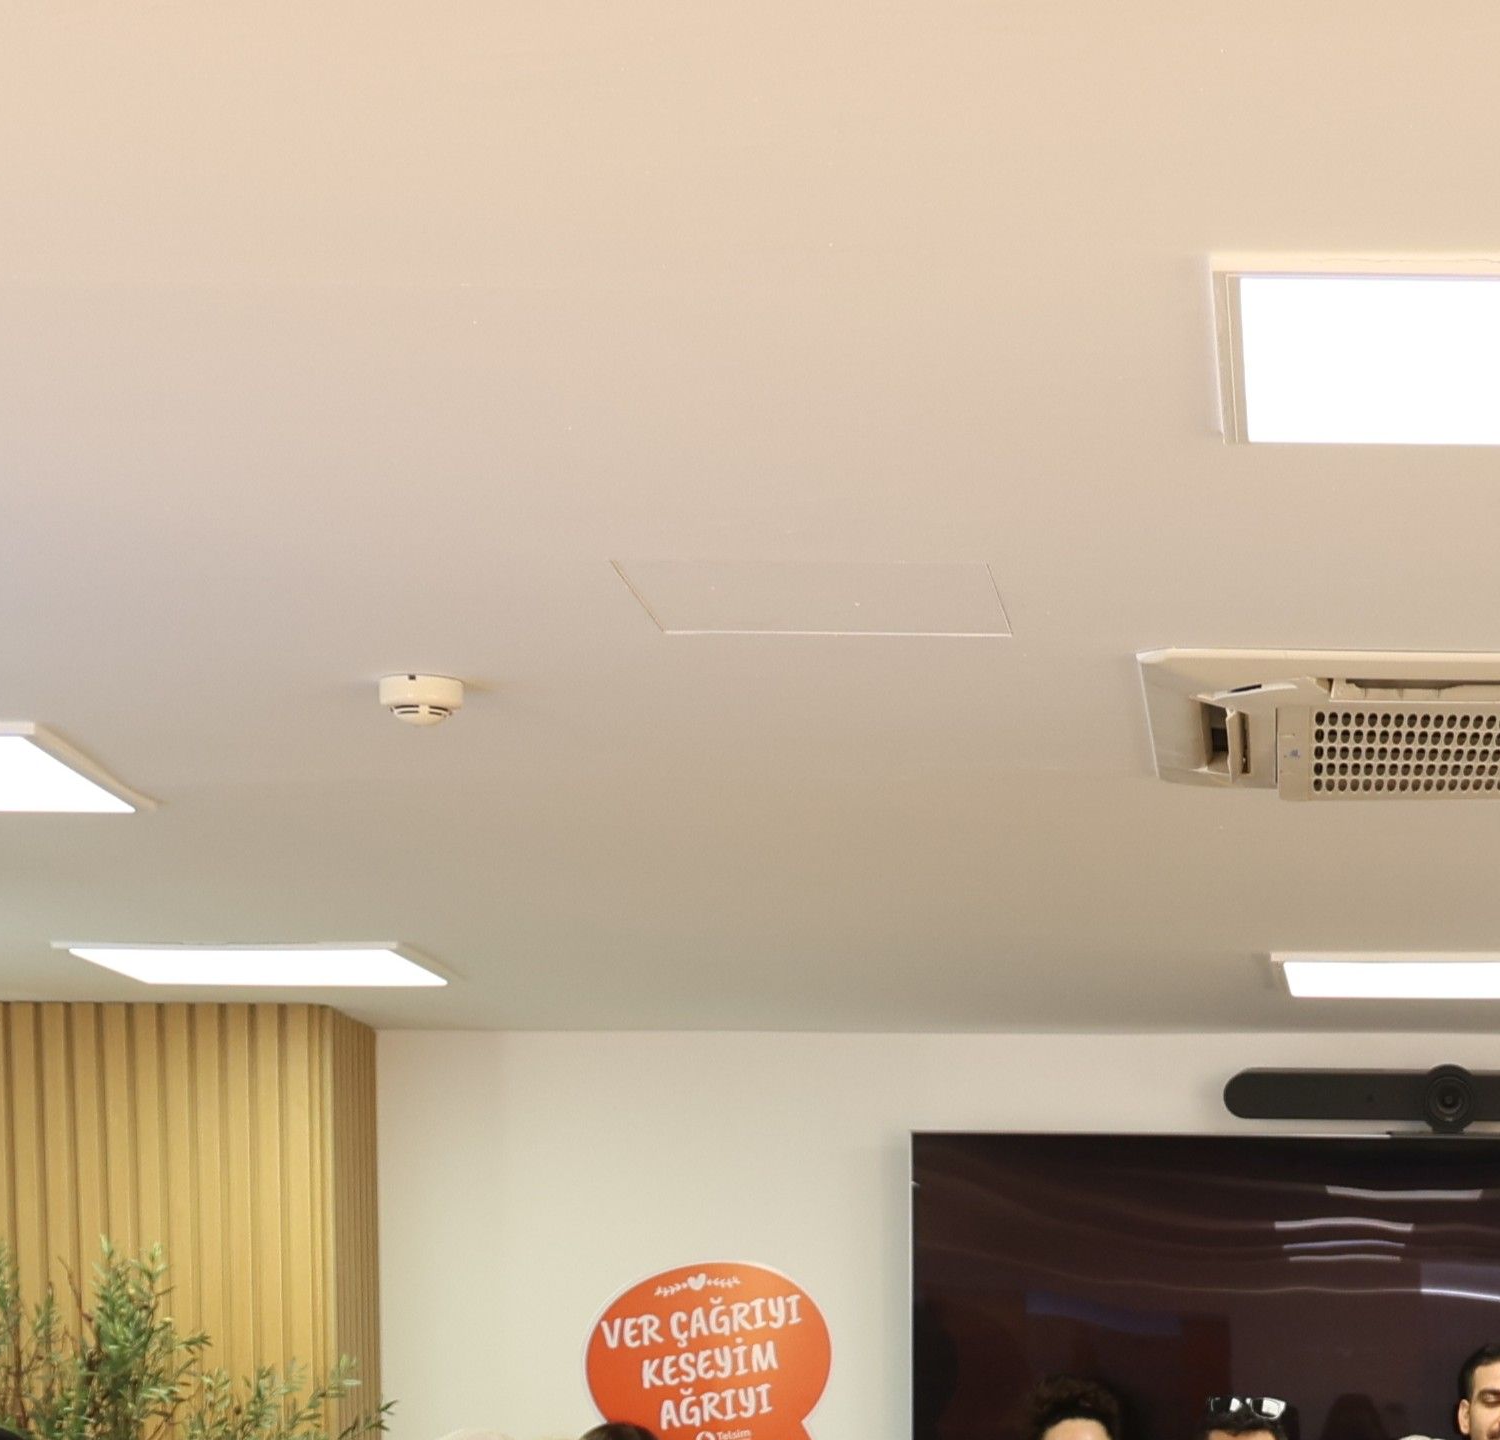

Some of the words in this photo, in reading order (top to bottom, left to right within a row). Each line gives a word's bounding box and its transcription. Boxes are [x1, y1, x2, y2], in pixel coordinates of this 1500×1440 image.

[600, 1313, 664, 1349] VER
[669, 1294, 802, 1348] ÇAĞRIYI
[641, 1336, 779, 1389] KESEYİM
[660, 1383, 773, 1430] AĞRIYI
